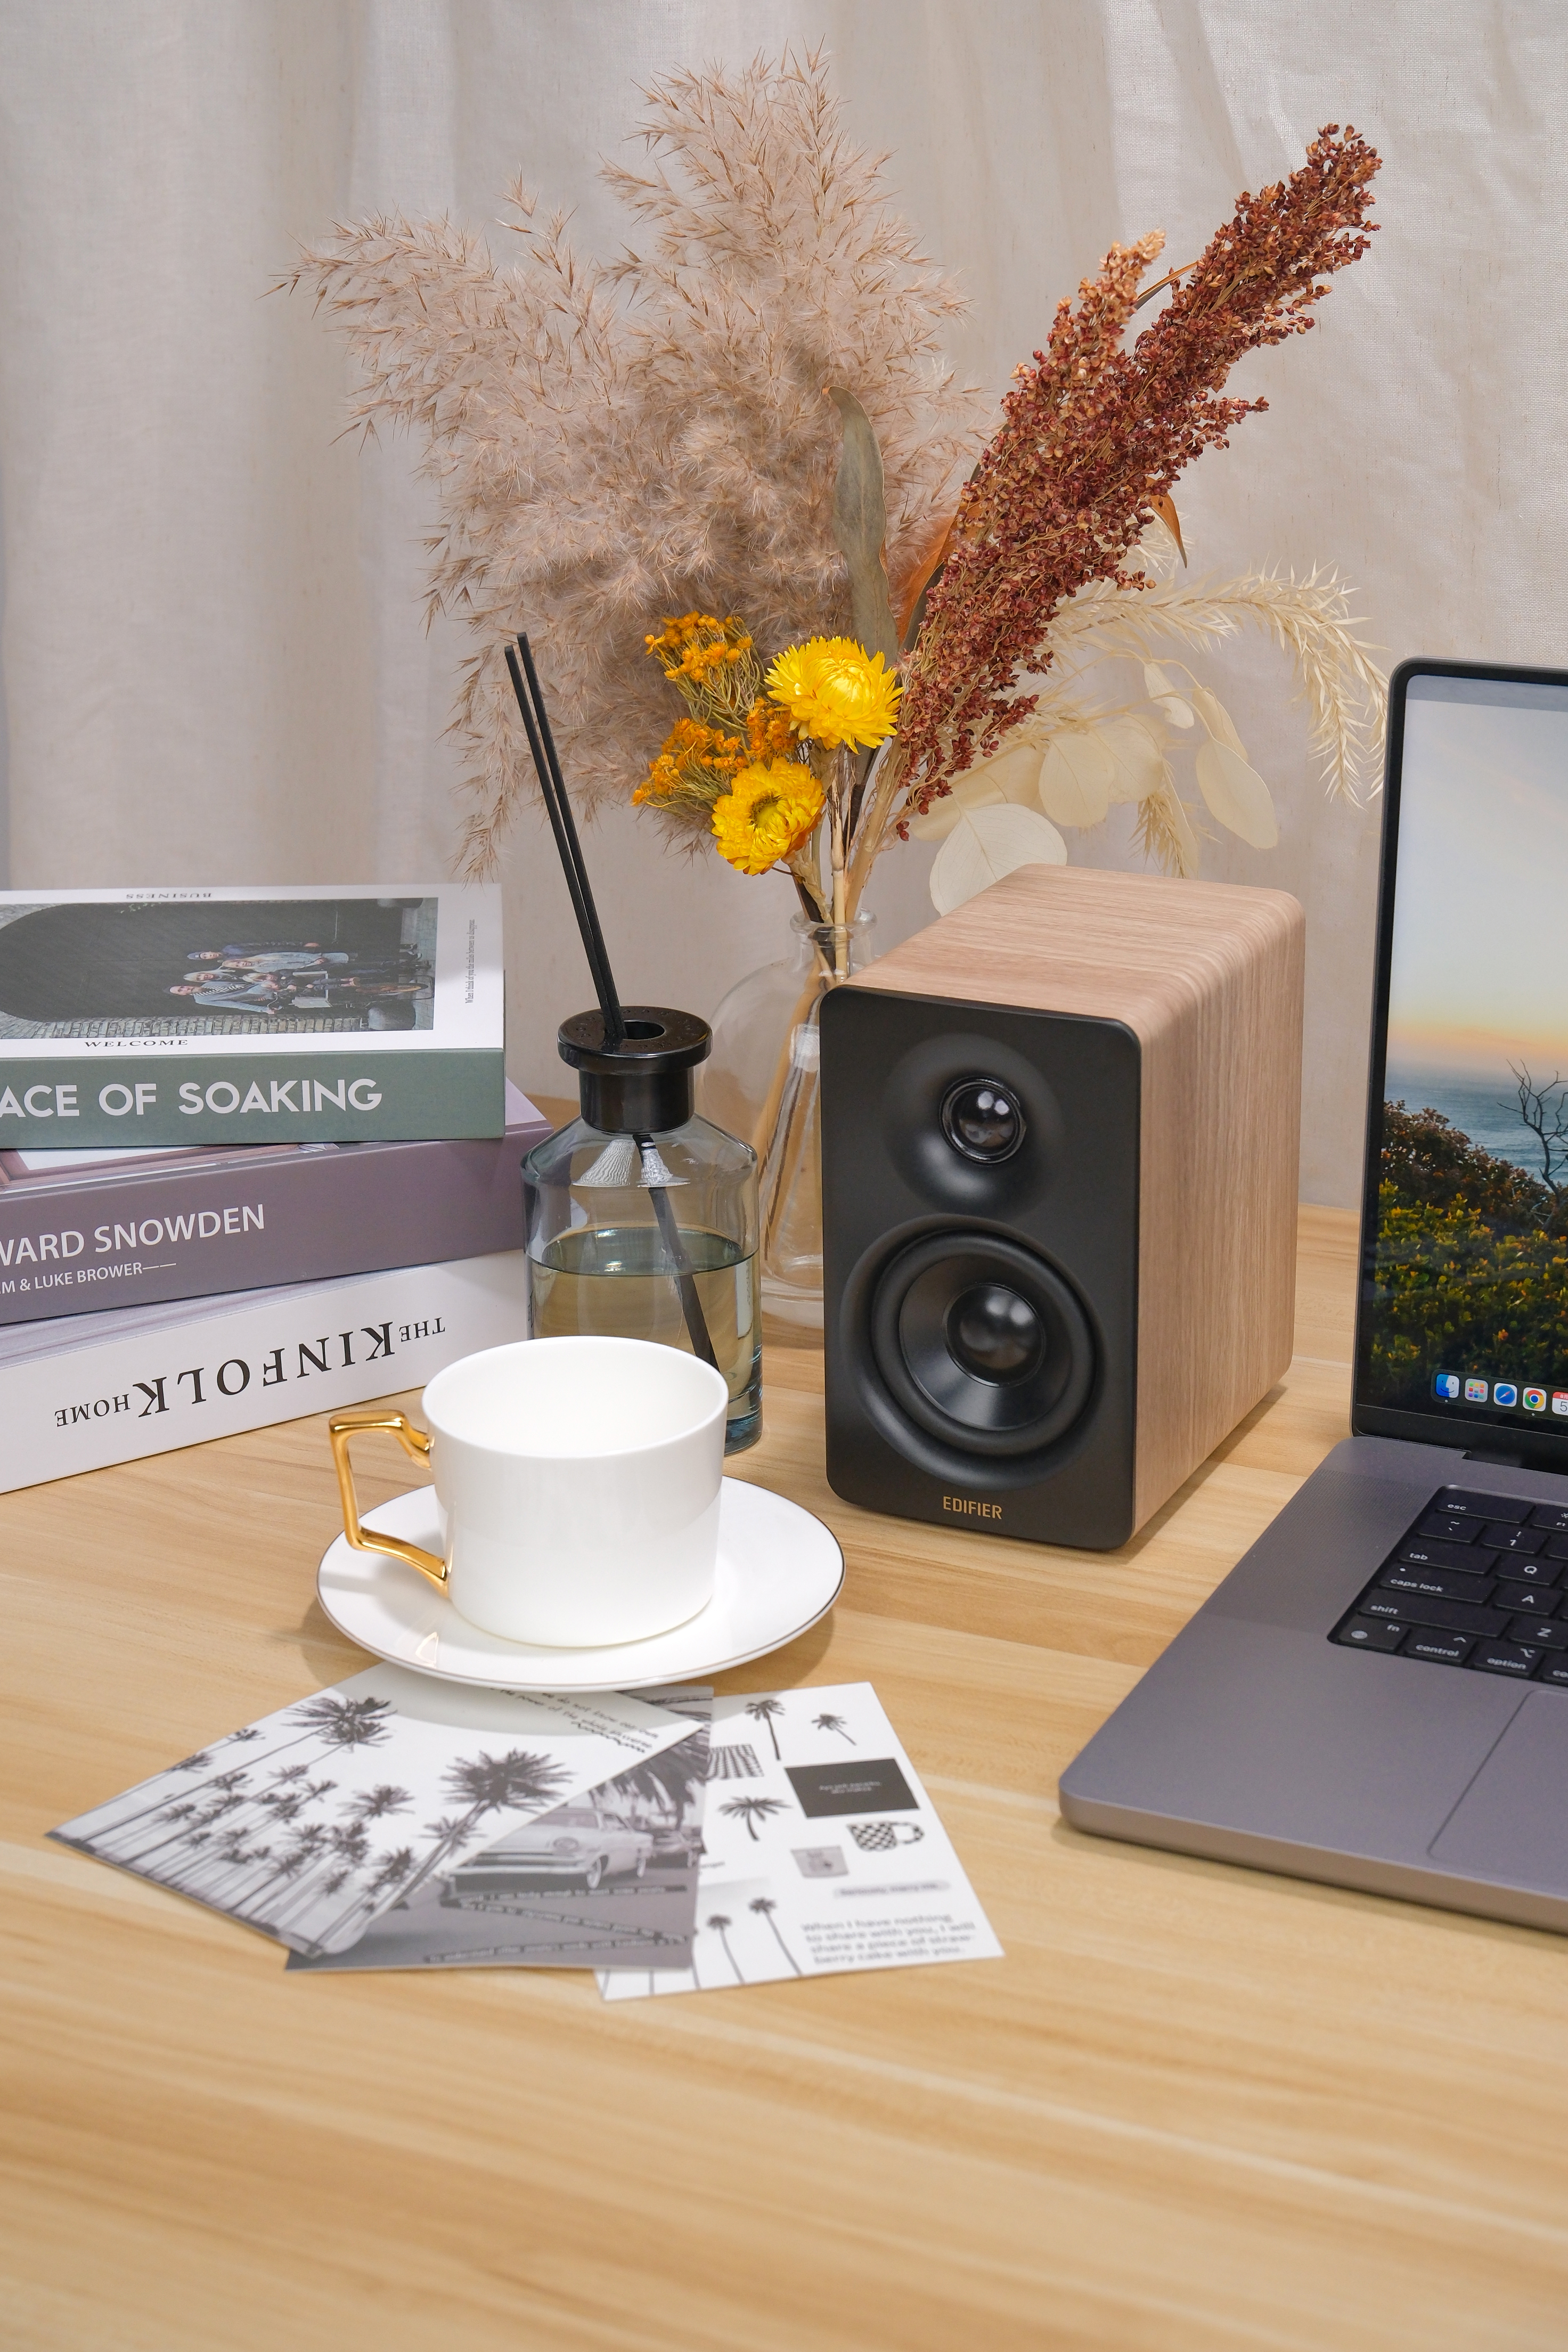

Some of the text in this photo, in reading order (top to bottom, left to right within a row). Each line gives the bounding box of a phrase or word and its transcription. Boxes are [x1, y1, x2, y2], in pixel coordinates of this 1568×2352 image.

[465, 992, 474, 1003] When
[84, 1039, 188, 1048] WELCOME
[98, 1083, 157, 1116] OF
[178, 1078, 383, 1115] SOAKING
[94, 1204, 265, 1253] SNOWDEN
[20, 1278, 31, 1291] &
[35, 1272, 74, 1289] LUKE
[54, 1317, 446, 1428] THE KINFOLK HOME
[1560, 1401, 1567, 1412] 5
[943, 1496, 1002, 1520] EDIFIER
[1524, 1565, 1538, 1575] Q
[1390, 1578, 1443, 1592] caps lock
[1521, 1595, 1535, 1604] A
[1370, 1604, 1399, 1614] shift
[1537, 1627, 1552, 1638] Z
[1415, 1644, 1460, 1657] control
[1487, 1657, 1527, 1670] option
